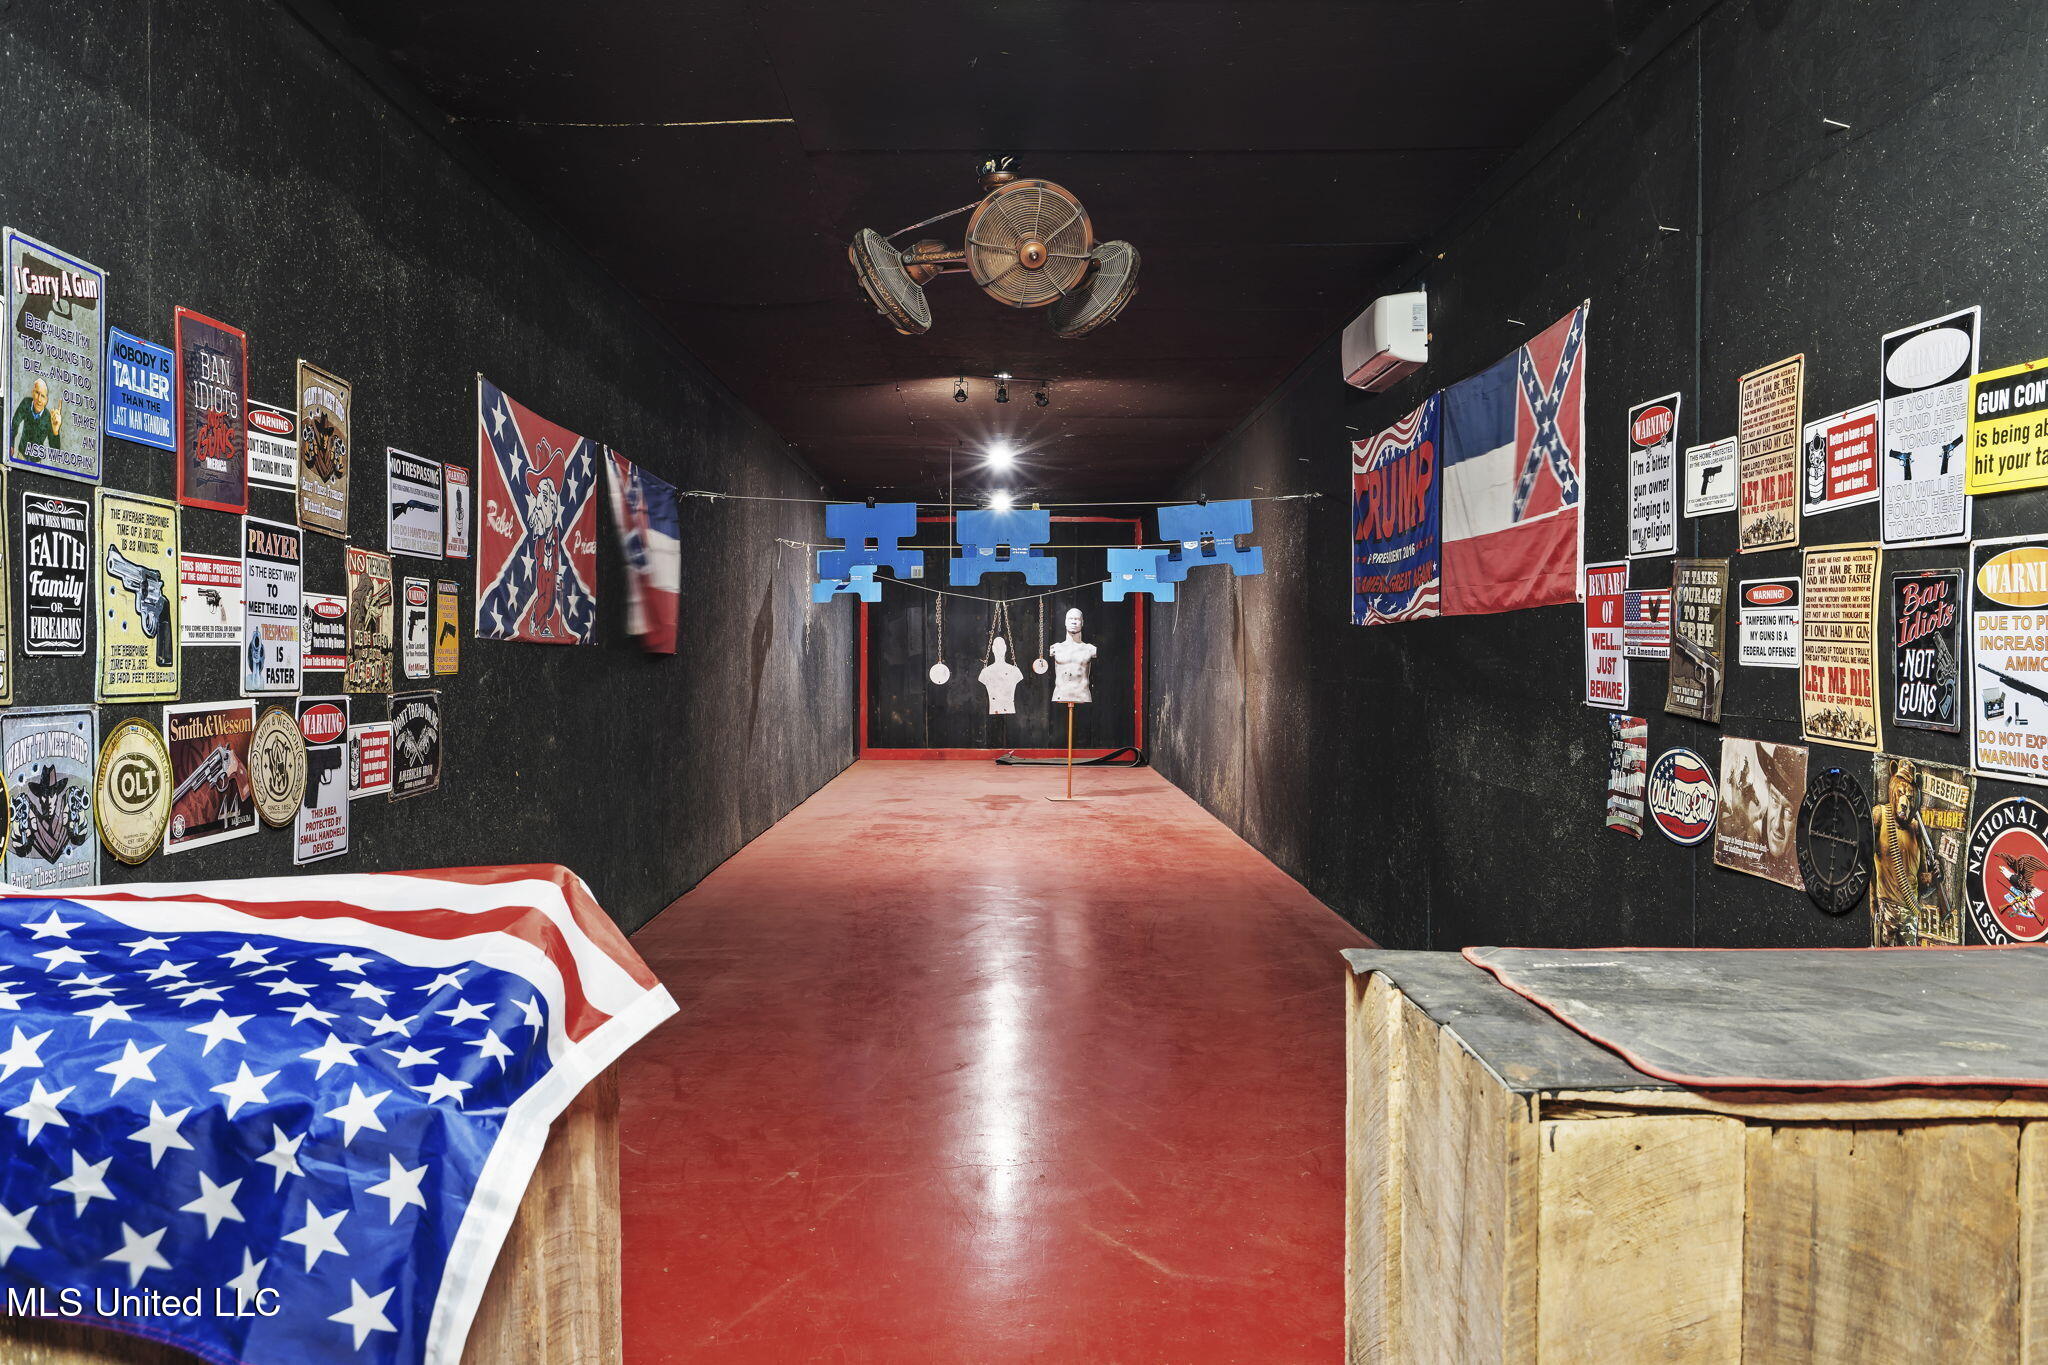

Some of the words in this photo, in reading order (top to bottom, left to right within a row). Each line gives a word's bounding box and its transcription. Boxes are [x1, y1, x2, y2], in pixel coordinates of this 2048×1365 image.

[14, 265, 22, 293] I
[22, 267, 59, 302] Carry
[62, 270, 72, 297] A
[72, 272, 98, 299] Gun
[25, 312, 74, 343] BECAUSE
[21, 334, 43, 354] TOO
[45, 343, 79, 366] YOUNG
[80, 355, 93, 371] TO
[114, 341, 156, 369] NOBODY
[160, 358, 169, 373] IS
[113, 359, 169, 401] TALLER
[200, 352, 230, 386] BAN
[72, 373, 91, 390] TOO
[63, 390, 82, 406] OLD
[84, 396, 96, 410] TO
[122, 393, 143, 408] THAN
[146, 400, 160, 412] THE
[194, 380, 238, 418] IDIOTS
[1977, 388, 2010, 415] GUN
[72, 413, 96, 431] TAKE
[112, 404, 127, 426] LAST
[129, 409, 142, 431] MAN
[144, 412, 170, 438] STANDING
[254, 413, 289, 431] WARNING
[1635, 411, 1671, 441] WARNING
[82, 437, 95, 451] AN
[197, 424, 235, 461] GUNS
[1976, 430, 1987, 448] is
[1992, 424, 2030, 445] being
[25, 442, 46, 460] ASS
[390, 458, 401, 475] NO
[401, 460, 439, 485] TRESPASSING
[1633, 460, 1644, 476] I'm
[1646, 461, 1650, 473] a
[1652, 454, 1670, 472] bitter
[1975, 454, 1994, 475] hit
[1999, 452, 2031, 476] your
[1354, 440, 1434, 541] TRUMP
[1634, 483, 1646, 501] gun
[1649, 478, 1669, 494] owner
[1742, 480, 1759, 507] LET
[1761, 475, 1775, 503] ME
[1778, 471, 1793, 500] DIE
[1633, 500, 1661, 521] clinging
[1663, 498, 1670, 514] to
[27, 512, 44, 527] DON'T
[45, 514, 60, 528] MESS
[61, 516, 76, 531] WITH
[76, 519, 84, 531] MY
[1632, 528, 1642, 541] my
[1644, 521, 1671, 541] religion
[30, 531, 85, 570] FAITH
[248, 528, 299, 560] PRAYER
[1403, 543, 1415, 559] 2016
[249, 564, 255, 577] IS
[255, 565, 267, 579] THE
[268, 567, 282, 580] BEST
[283, 570, 297, 582] WAY
[349, 552, 366, 573] NO
[29, 570, 84, 606] Family
[1588, 572, 1625, 596] BEWARE
[1682, 570, 1690, 584] IT
[1691, 570, 1718, 585] TAKES
[267, 584, 278, 598] TO
[1677, 586, 1721, 604] COURAGE
[1752, 589, 1785, 600] WARNING!
[1902, 580, 1948, 616] Ban
[50, 602, 63, 613] OR
[248, 601, 265, 613] MEET
[266, 603, 278, 614] THE
[279, 604, 297, 616] LORD
[1602, 600, 1614, 623] OF
[1683, 605, 1695, 620] TO
[1698, 606, 1710, 621] BE
[30, 616, 81, 640] FIREARMS
[1745, 615, 1776, 626] TAMPERING
[1778, 615, 1793, 625] WITH
[1897, 601, 1956, 648] Idiots
[1978, 615, 2008, 630] DUE
[2012, 615, 2032, 630] TO
[261, 623, 299, 642] TRESPASSING
[1680, 621, 1714, 647] FREE
[1750, 631, 1758, 640] MY
[1760, 631, 1775, 640] GUNS
[1776, 631, 1783, 640] IS
[1783, 631, 1788, 640] A
[276, 646, 284, 662] IS
[1627, 646, 1637, 655] 2nd
[1637, 647, 1668, 657] Amendment
[1743, 645, 1767, 656] FEDERAL
[1768, 646, 1797, 657] OFFENSE!
[266, 667, 295, 684] FASTER
[1596, 656, 1617, 675] JUST
[1590, 680, 1622, 701] BEWARE
[1805, 665, 1825, 693] LET
[1828, 666, 1847, 694] ME
[1850, 667, 1871, 697] DIE
[1899, 681, 1937, 717] GUNS
[276, 716, 300, 750] WESSON
[303, 713, 343, 735] WARNING
[1978, 729, 1996, 744] DO
[1999, 731, 2023, 747] NOT
[6, 734, 34, 778] WANT
[35, 731, 46, 760] TO
[47, 730, 69, 758] MEET
[70, 732, 88, 768] GOD?
[1979, 747, 2039, 769] WARNING
[1652, 778, 1668, 809] Old
[1668, 782, 1691, 822] Guys
[1691, 787, 1713, 823] Rule
[1924, 774, 1928, 790] I
[1930, 778, 1966, 806] RESERVE
[218, 792, 241, 829] 44
[231, 814, 252, 826] MAGNUM
[311, 808, 323, 819] THIS
[324, 805, 337, 817] AREA
[1921, 810, 1935, 826] MY
[1937, 810, 1964, 828] RIGHT
[305, 818, 335, 832] PROTECTED
[335, 815, 342, 826] BY
[300, 832, 318, 845] SMALL
[318, 826, 346, 840] HANDHELD
[1969, 805, 2038, 875] NATIONAL
[312, 841, 334, 854] DEVICES
[10, 872, 32, 889] Enter
[34, 865, 57, 887] These
[58, 861, 90, 882] Premises
